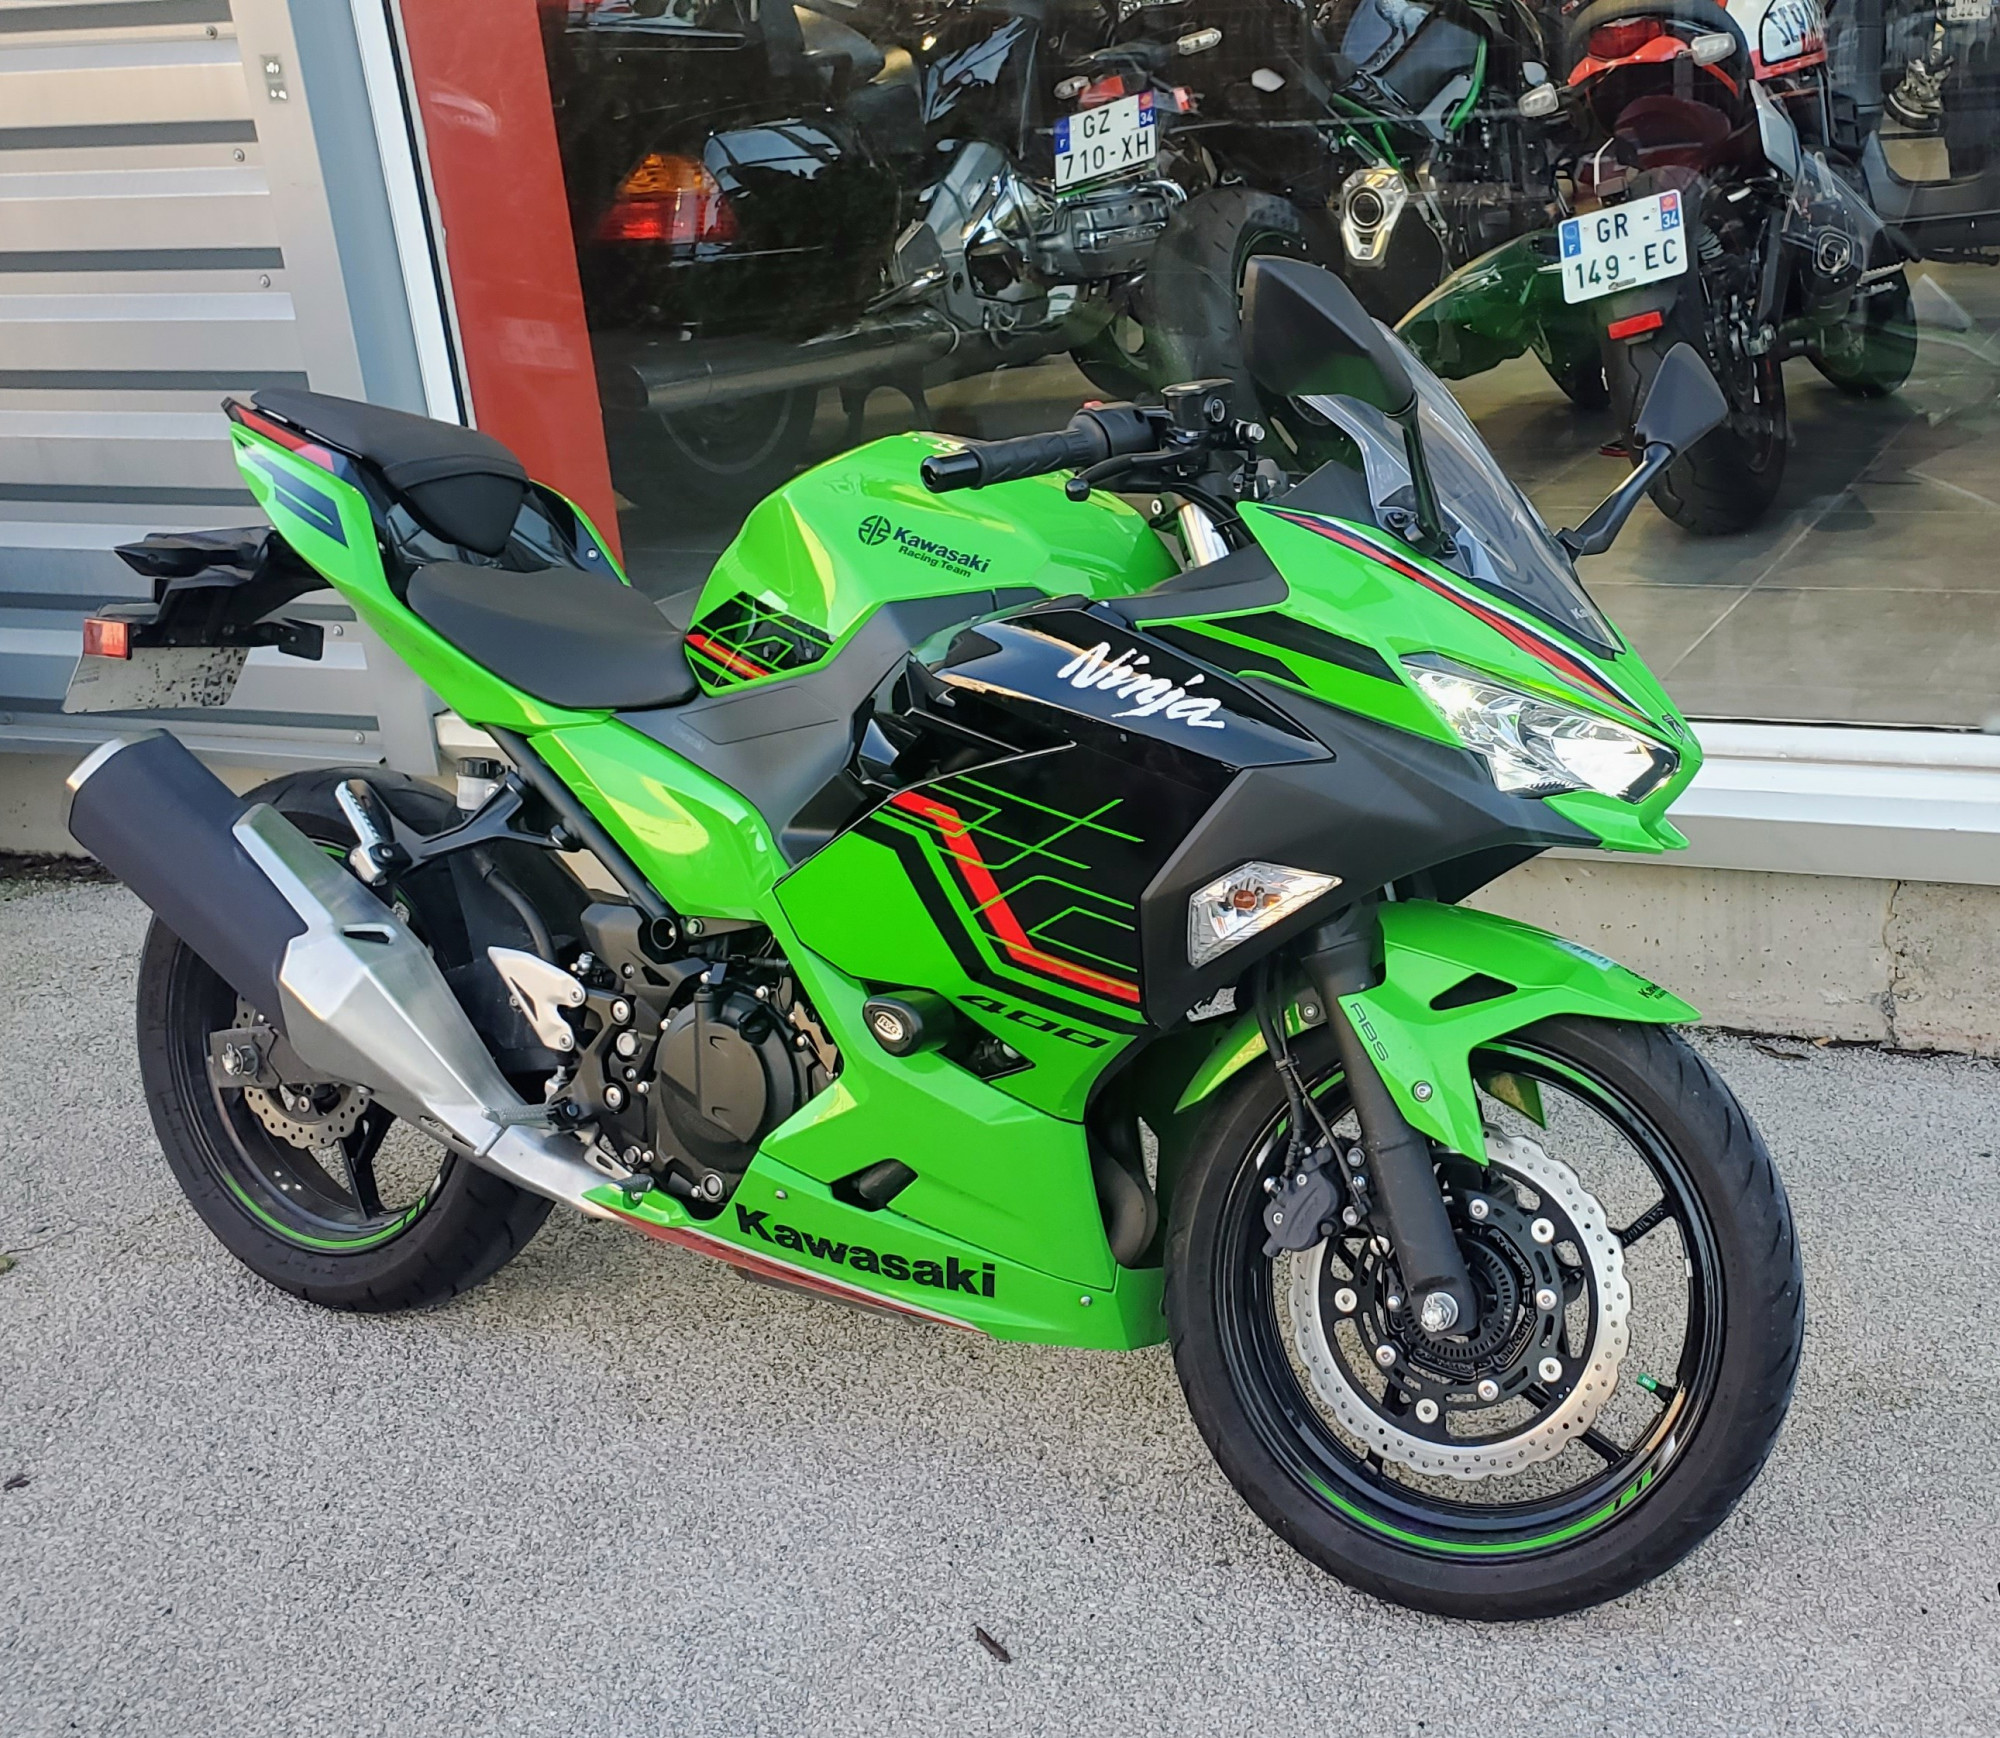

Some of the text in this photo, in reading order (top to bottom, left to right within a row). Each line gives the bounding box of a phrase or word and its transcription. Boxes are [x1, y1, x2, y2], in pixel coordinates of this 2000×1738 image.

[1083, 108, 1111, 139] GZ
[1140, 110, 1154, 125] 34
[1060, 139, 1066, 149] F
[1062, 130, 1149, 180] 710-XH
[1596, 213, 1629, 243] GR
[1662, 211, 1678, 228] 34
[1568, 244, 1576, 255] F
[892, 526, 993, 573] Kawasaki
[898, 545, 972, 578] Racing Team
[1056, 641, 1226, 729] Ninja
[956, 994, 1112, 1049] 400
[1350, 1002, 1389, 1062] ABS
[734, 1202, 996, 1298] Kawasaki
